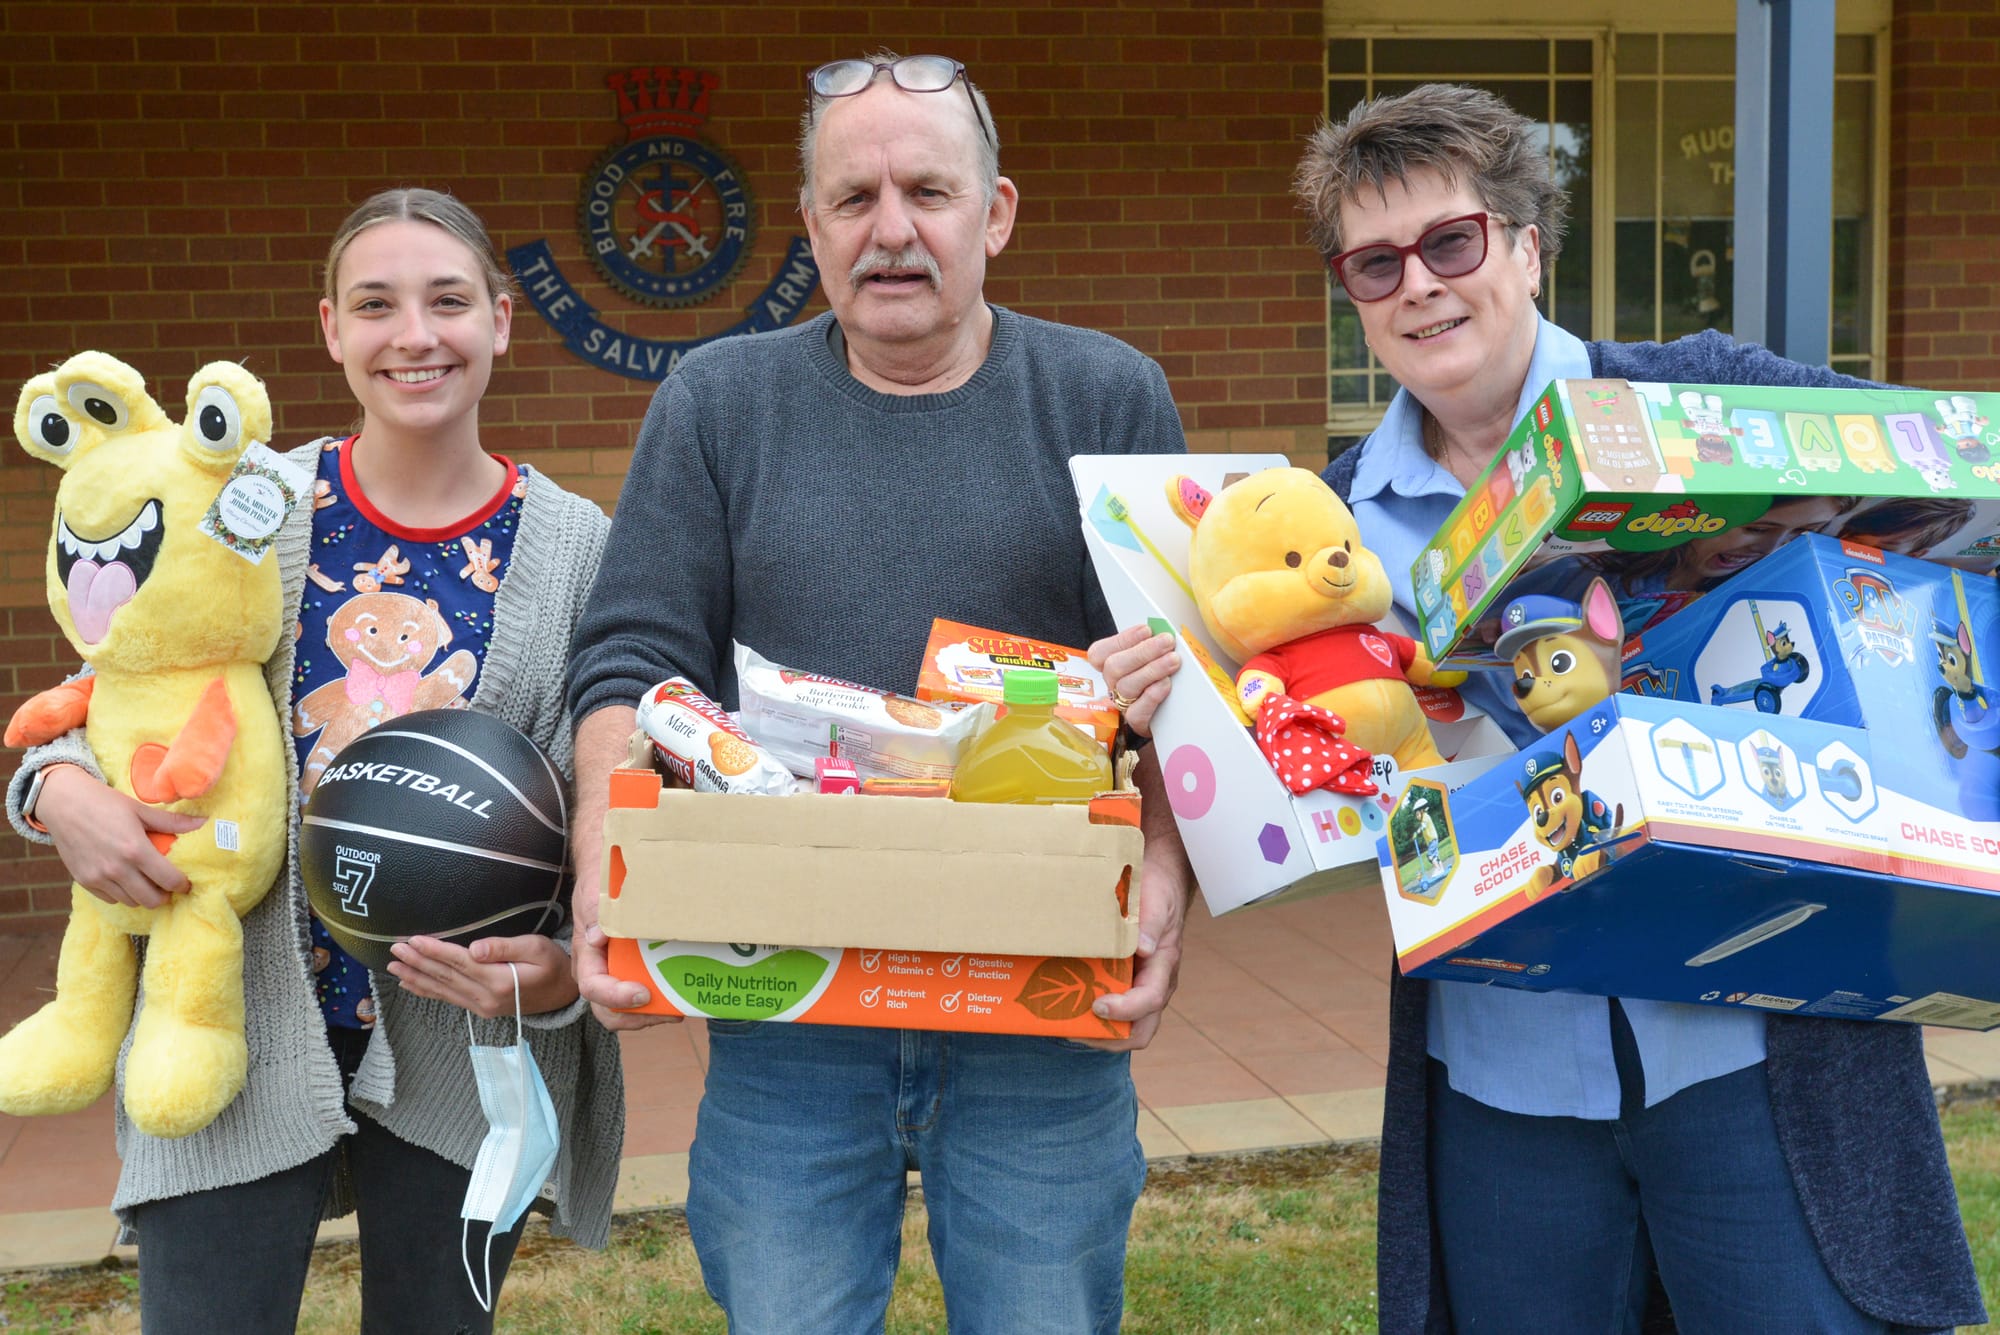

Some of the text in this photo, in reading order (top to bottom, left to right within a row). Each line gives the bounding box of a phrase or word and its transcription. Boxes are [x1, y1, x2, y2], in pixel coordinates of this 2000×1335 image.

[590, 142, 746, 254] BLOOD AND FIRE
[522, 240, 814, 375] THE SALVA ARMY
[1544, 433, 1563, 489] duplo
[1576, 511, 1726, 537] LEGO duplo
[1845, 548, 1882, 564] nickelodeon
[1832, 578, 1918, 639] PAW
[1865, 631, 1907, 650] PATROL
[995, 656, 1051, 668] ORIGINALS
[804, 674, 880, 694] ARNOTT
[794, 692, 870, 711] Snap Cookie
[808, 688, 865, 703] Butternut
[665, 712, 697, 739] Marie
[1591, 717, 1607, 734] 3+
[317, 762, 493, 819] BASKETBALL
[1901, 822, 2000, 855] CHASE SC
[335, 845, 381, 864] OUTDOOR
[1480, 841, 1529, 877] CHASE
[1474, 851, 1541, 896] SCOOTER
[332, 856, 375, 917] SIZE 7
[888, 953, 921, 964] High in
[968, 958, 1014, 969] Digestive
[887, 966, 934, 976] Vitamin C
[968, 970, 1011, 980] Function
[684, 972, 797, 992] Daily Nutrition
[697, 991, 783, 1011] Made Easy
[887, 988, 926, 999] Nutrient
[967, 993, 1002, 1005] Dietary
[887, 1000, 908, 1009] Rich
[967, 1005, 992, 1014] Fibre
